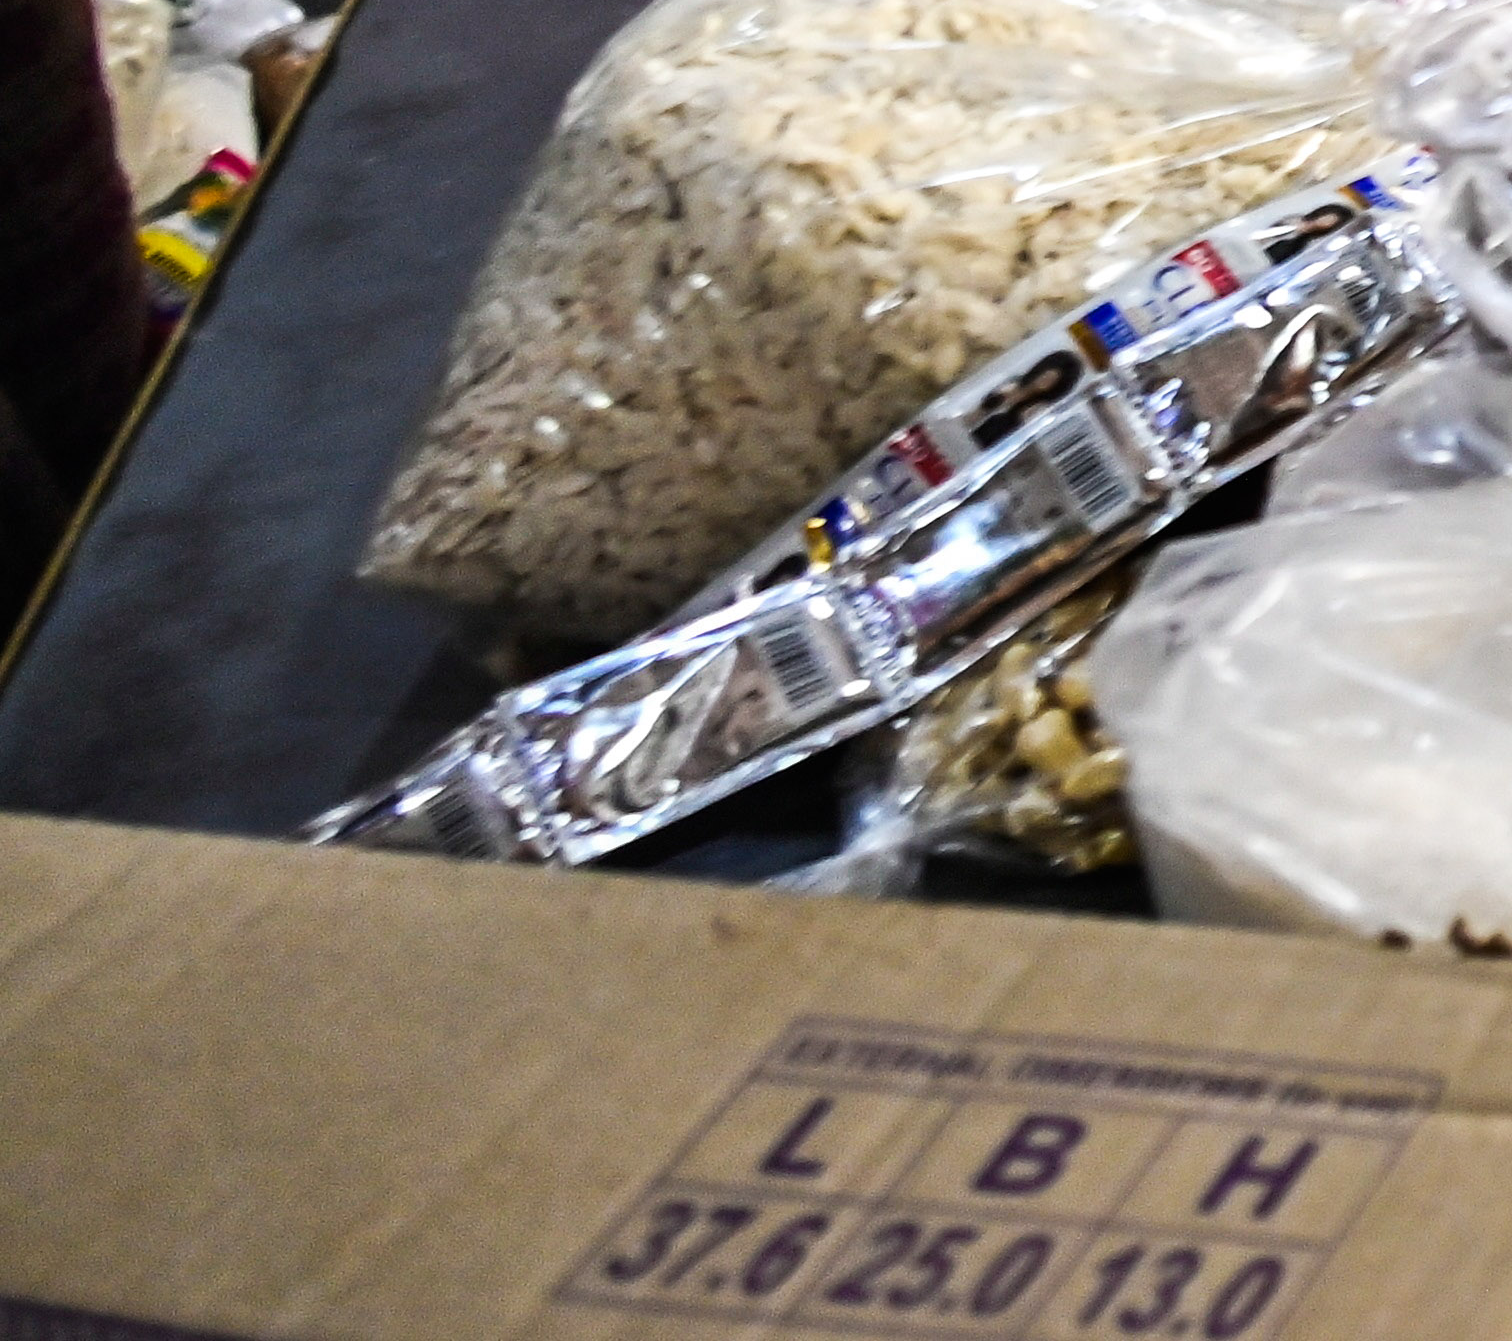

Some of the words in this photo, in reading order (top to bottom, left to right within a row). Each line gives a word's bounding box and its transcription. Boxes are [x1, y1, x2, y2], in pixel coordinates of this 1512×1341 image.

[760, 1097, 835, 1180] L
[973, 1114, 1089, 1197] B
[1199, 1135, 1320, 1222] H
[605, 1197, 830, 1299] 37.6
[825, 1219, 1059, 1319] 25.0
[1079, 1242, 1287, 1341] 13.0
